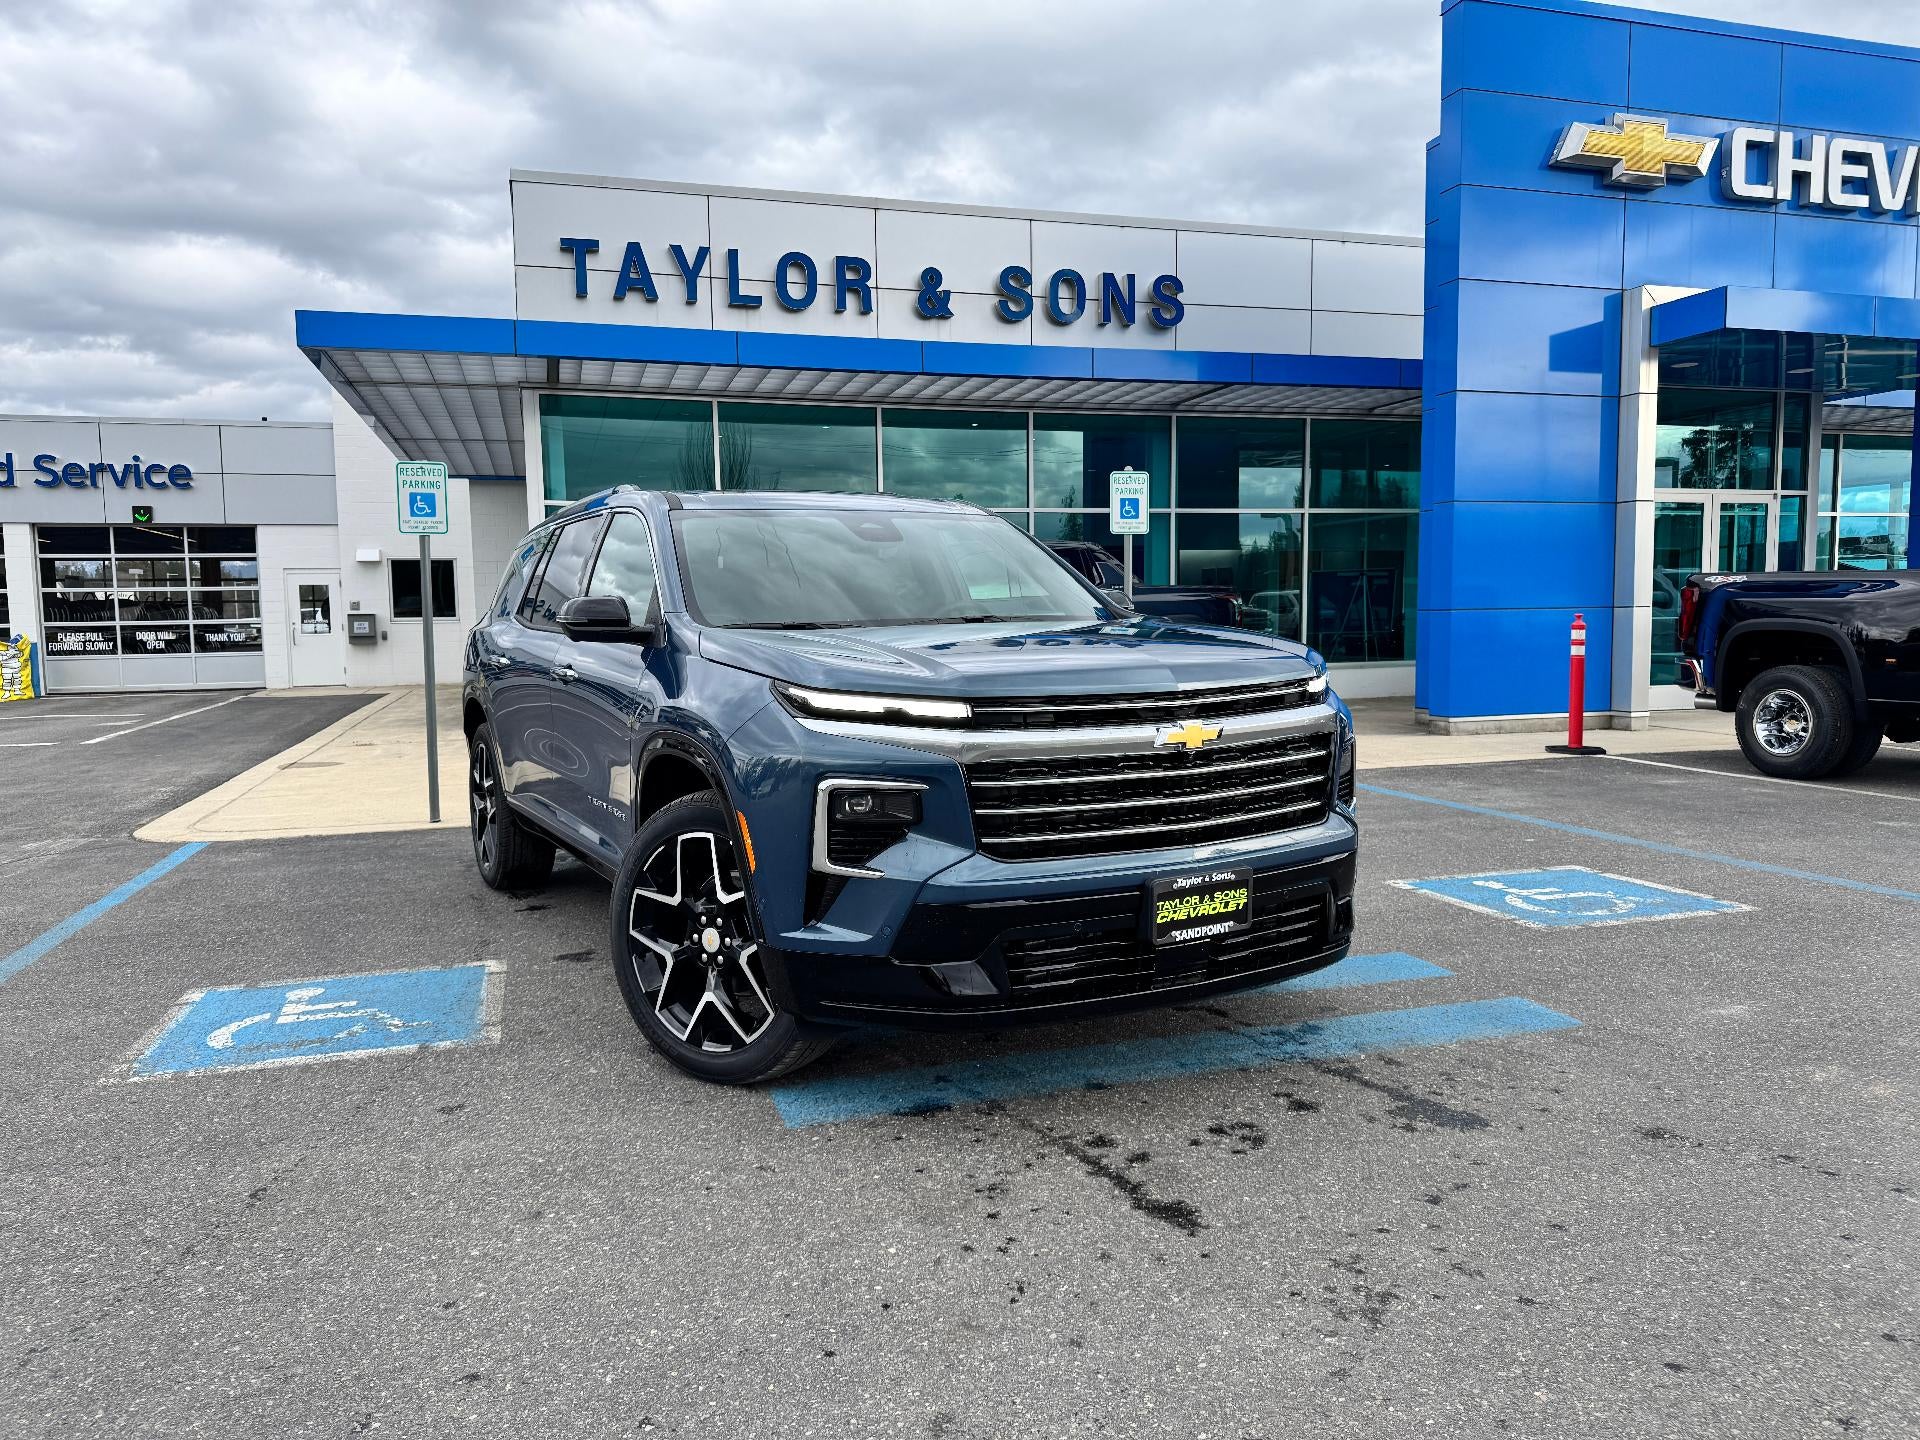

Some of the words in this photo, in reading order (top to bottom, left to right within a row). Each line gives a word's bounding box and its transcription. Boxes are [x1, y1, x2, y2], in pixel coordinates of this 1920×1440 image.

[1724, 127, 1920, 212] CHEV
[559, 237, 873, 315] TAYLOR
[916, 266, 954, 319] &
[996, 265, 1185, 328] SONS
[33, 454, 193, 489] Service
[399, 467, 443, 477] RESERVED
[402, 479, 441, 490] PARKING
[1113, 476, 1146, 485] RESERVED
[1115, 487, 1144, 496] PARKING
[57, 632, 86, 642] PLEASE
[86, 632, 104, 641] PULL
[136, 631, 157, 641] DOOR
[157, 631, 174, 640] WILL
[205, 633, 229, 642] THANK
[229, 633, 246, 642] YOU!
[49, 642, 85, 651] FORWARD
[85, 641, 114, 651] SLOWLY
[146, 640, 165, 650] OPEN
[1176, 876, 1203, 889] Taylor
[1204, 874, 1210, 882] &
[1211, 871, 1232, 882] Sons
[1156, 895, 1200, 911] TAYLOR
[1203, 894, 1211, 905] &
[1213, 887, 1248, 902] SONS
[1156, 898, 1248, 924] CHEVROLET
[1174, 922, 1230, 942] SANDPOINT
